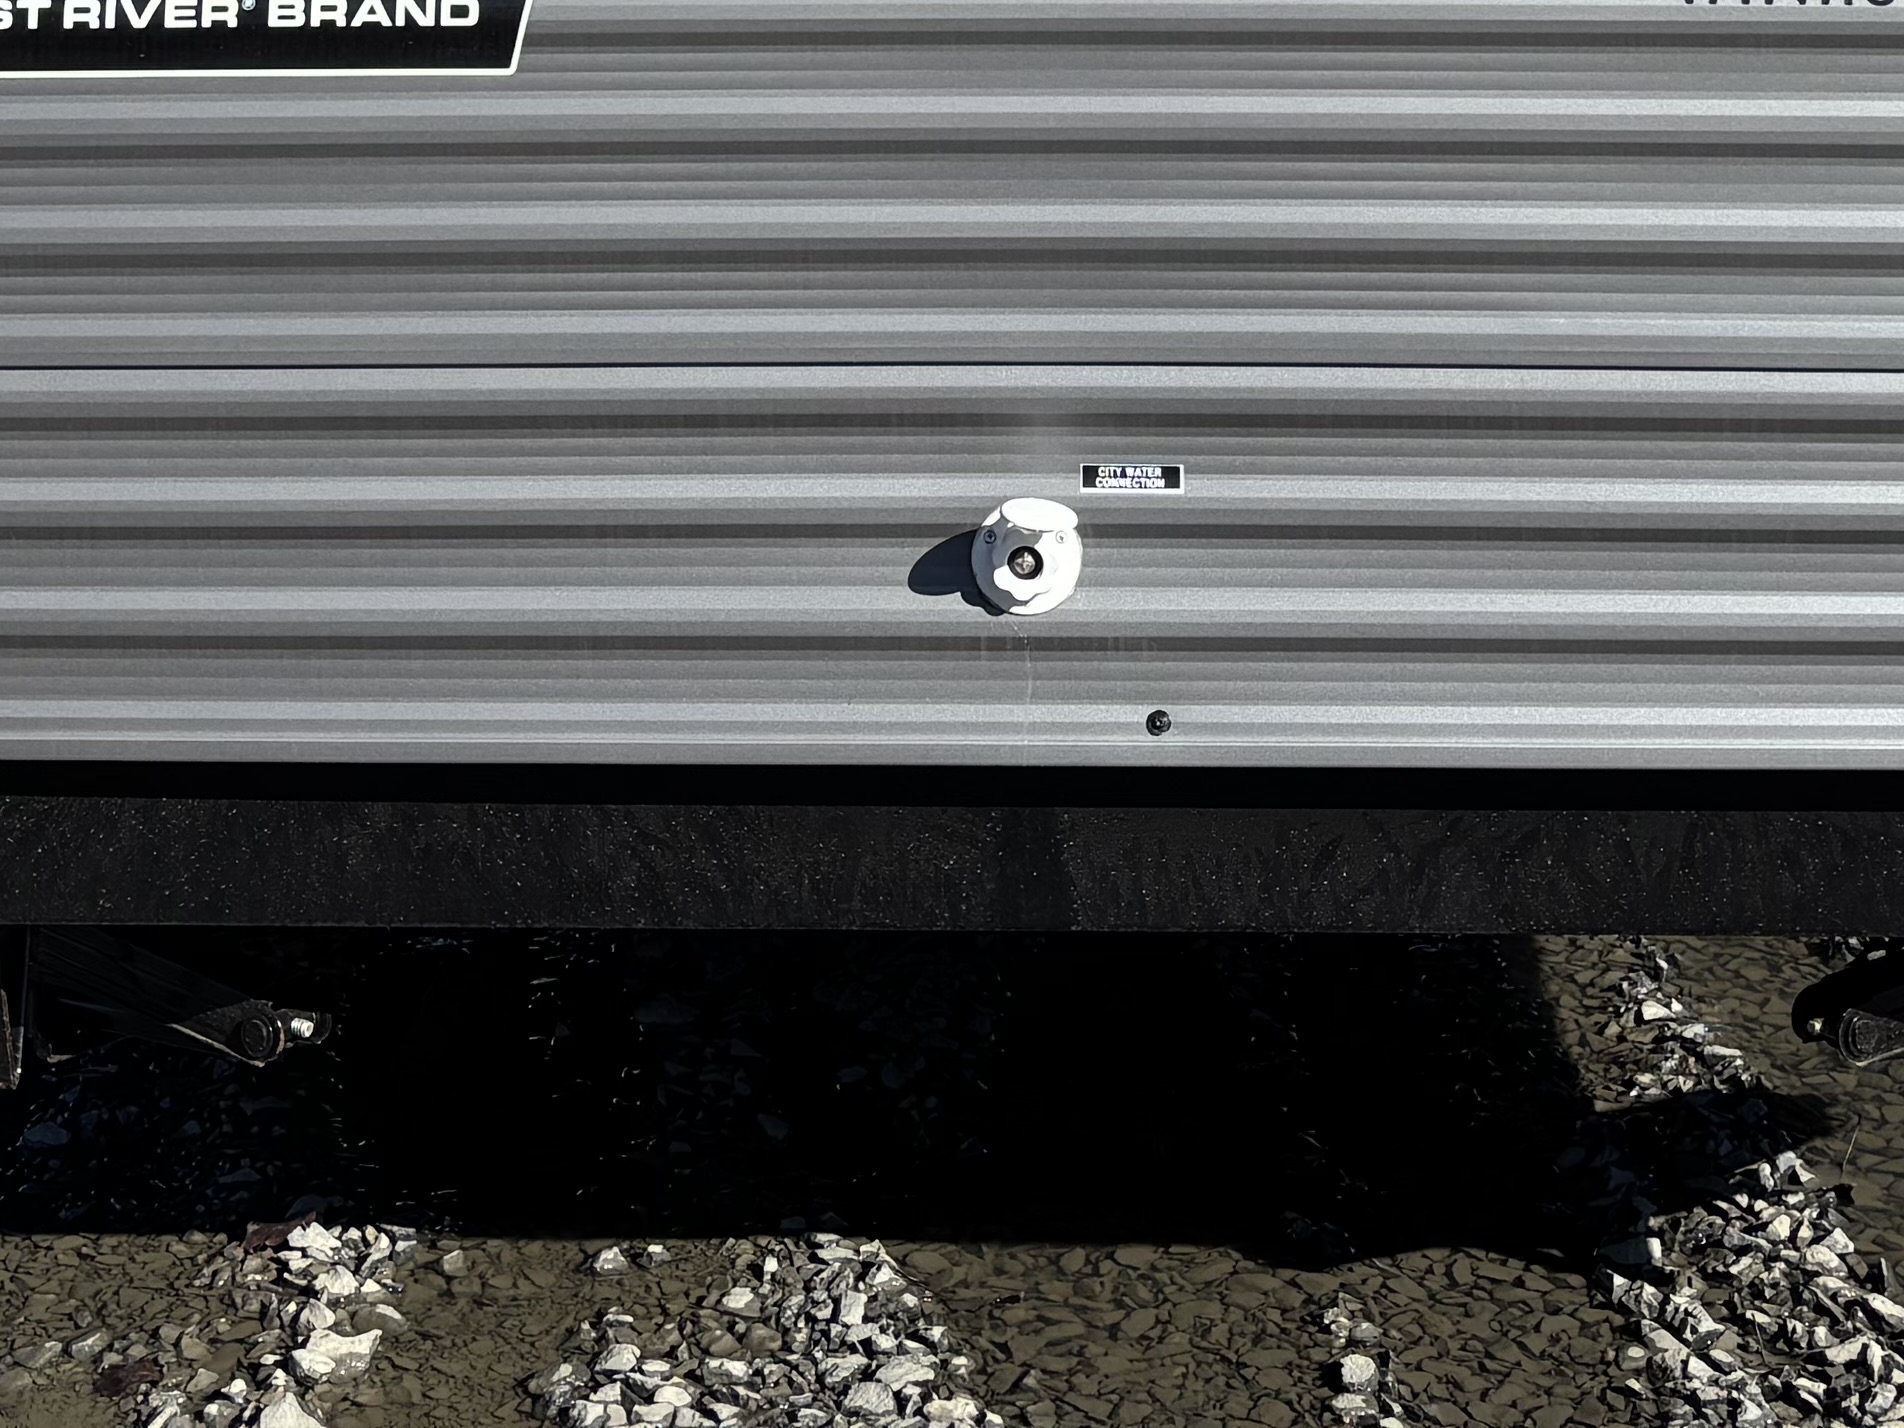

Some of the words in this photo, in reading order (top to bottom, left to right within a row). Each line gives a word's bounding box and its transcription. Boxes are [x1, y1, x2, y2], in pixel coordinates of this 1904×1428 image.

[1098, 466, 1122, 477] CITY
[1125, 467, 1162, 478] WATER
[1095, 477, 1165, 488] CONNECTION
